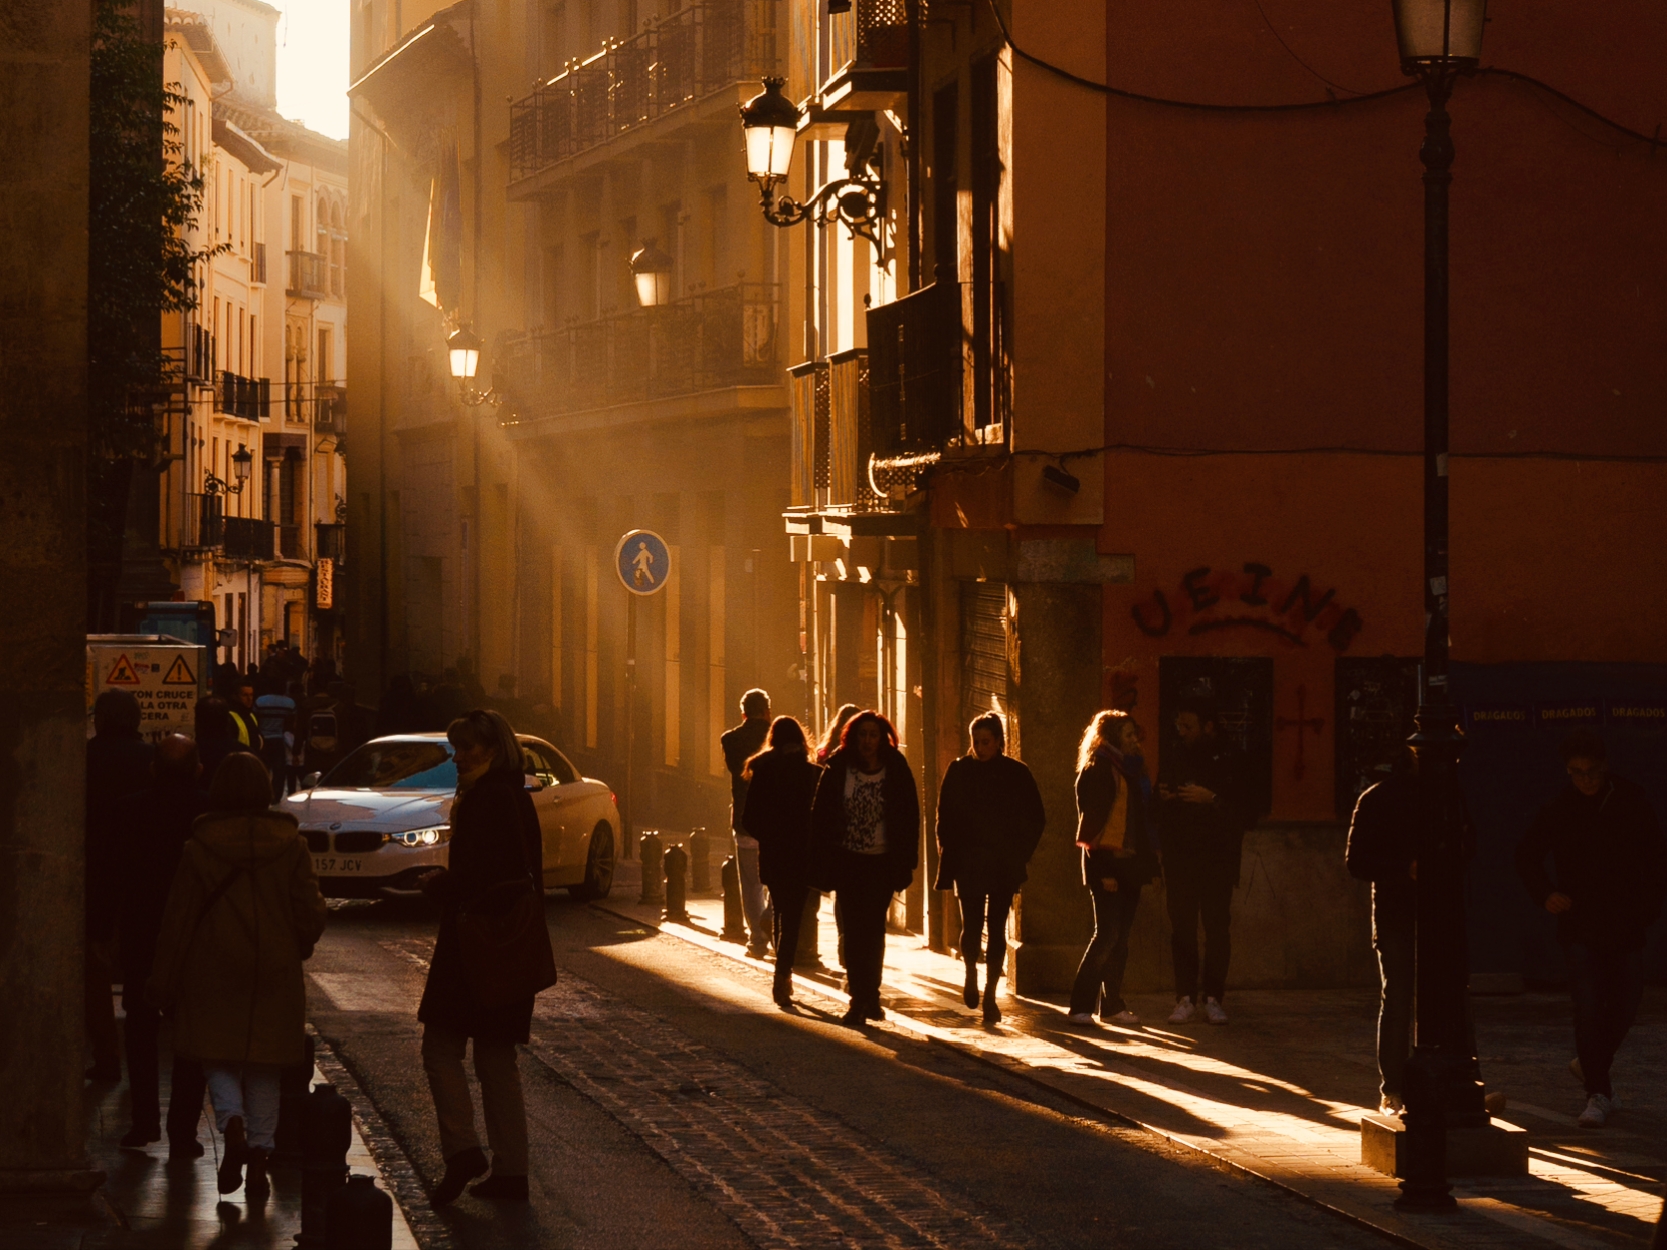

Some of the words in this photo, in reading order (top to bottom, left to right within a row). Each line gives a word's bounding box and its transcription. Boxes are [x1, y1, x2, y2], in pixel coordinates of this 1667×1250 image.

[156, 690, 193, 699] CRUCE
[140, 701, 154, 710] LA
[157, 701, 187, 710] OTRA
[141, 712, 169, 721] CERA
[1473, 710, 1526, 721] DRAGADOS
[1541, 707, 1597, 720] DRAGADOS
[1612, 707, 1666, 718] DRAGADOS
[315, 858, 336, 871] 157
[340, 859, 362, 871] JCV
